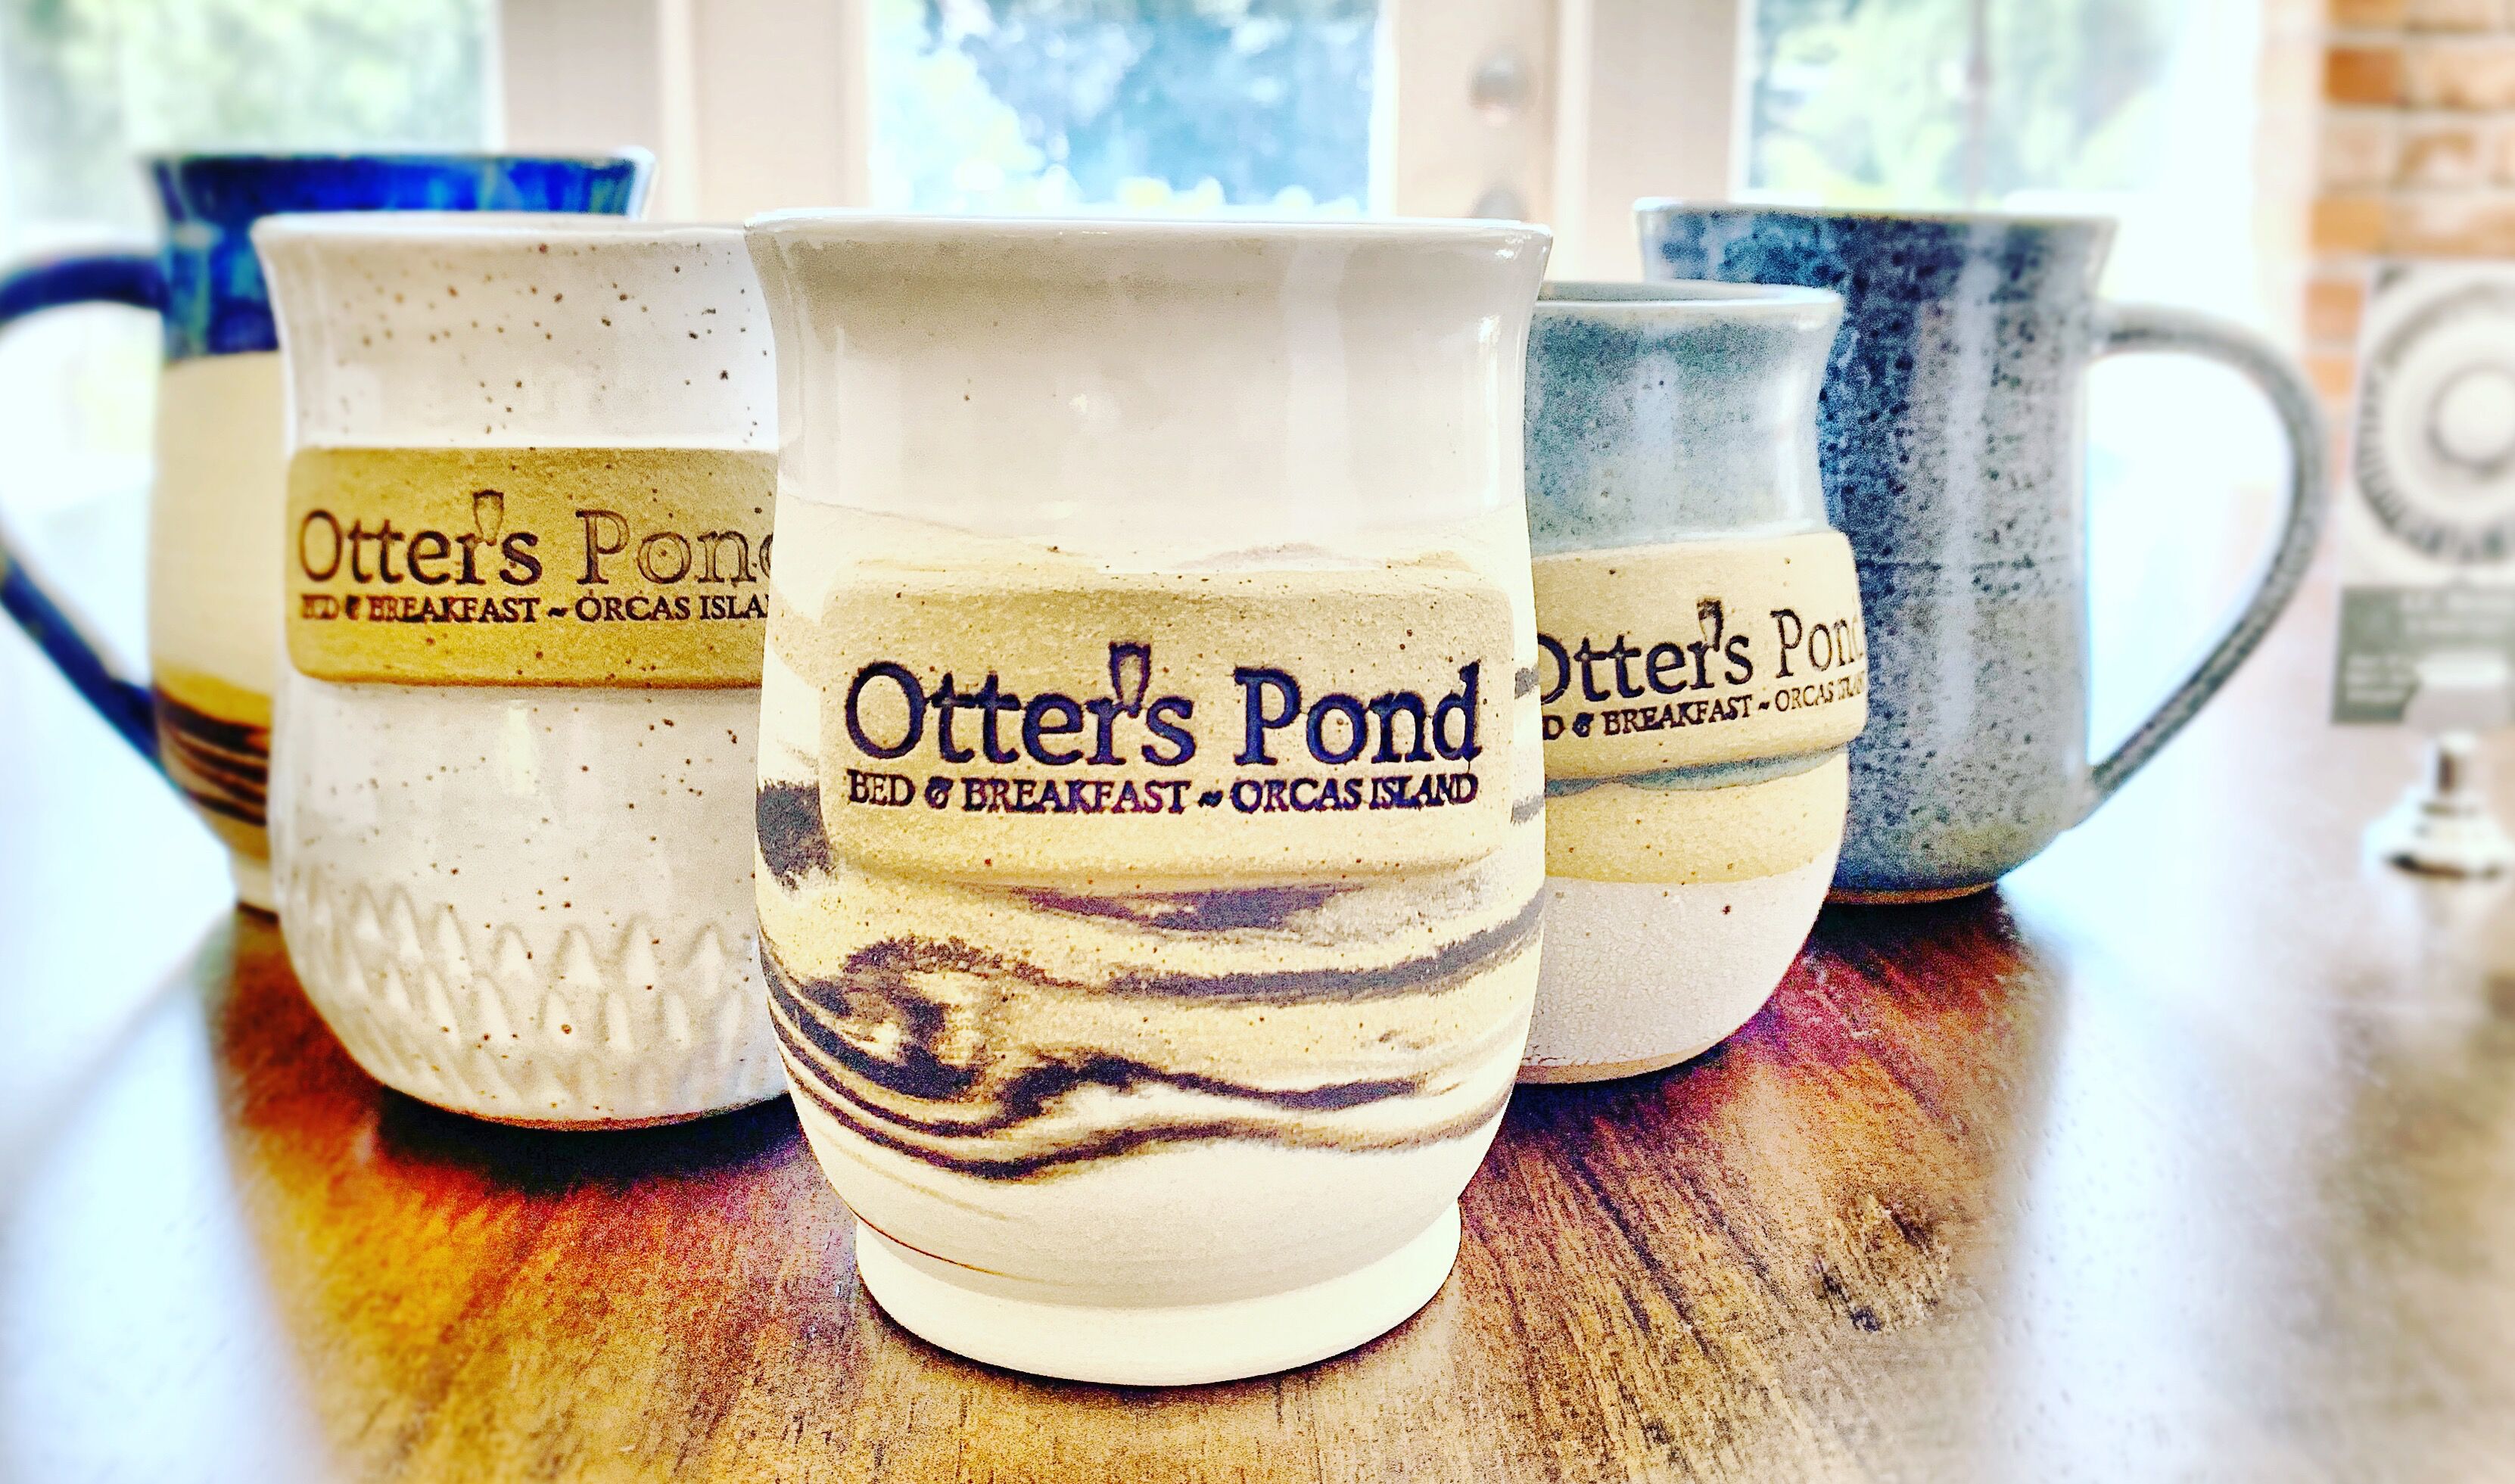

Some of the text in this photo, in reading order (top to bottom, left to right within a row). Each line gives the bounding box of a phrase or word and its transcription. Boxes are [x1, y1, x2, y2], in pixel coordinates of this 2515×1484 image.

[298, 489, 543, 586] Otter's
[366, 593, 541, 624] BREAKFAST
[575, 595, 691, 623] ORCAS
[699, 593, 770, 620] ISLA
[845, 642, 1484, 767] Otter's Pond
[1601, 693, 1752, 736] BREAKFAST
[1775, 681, 1834, 712] ORCAS
[846, 768, 916, 807] BED
[960, 776, 1191, 816] BREAKFAST
[1229, 777, 1363, 814] ORCAS
[1369, 772, 1478, 810] ISLAND
